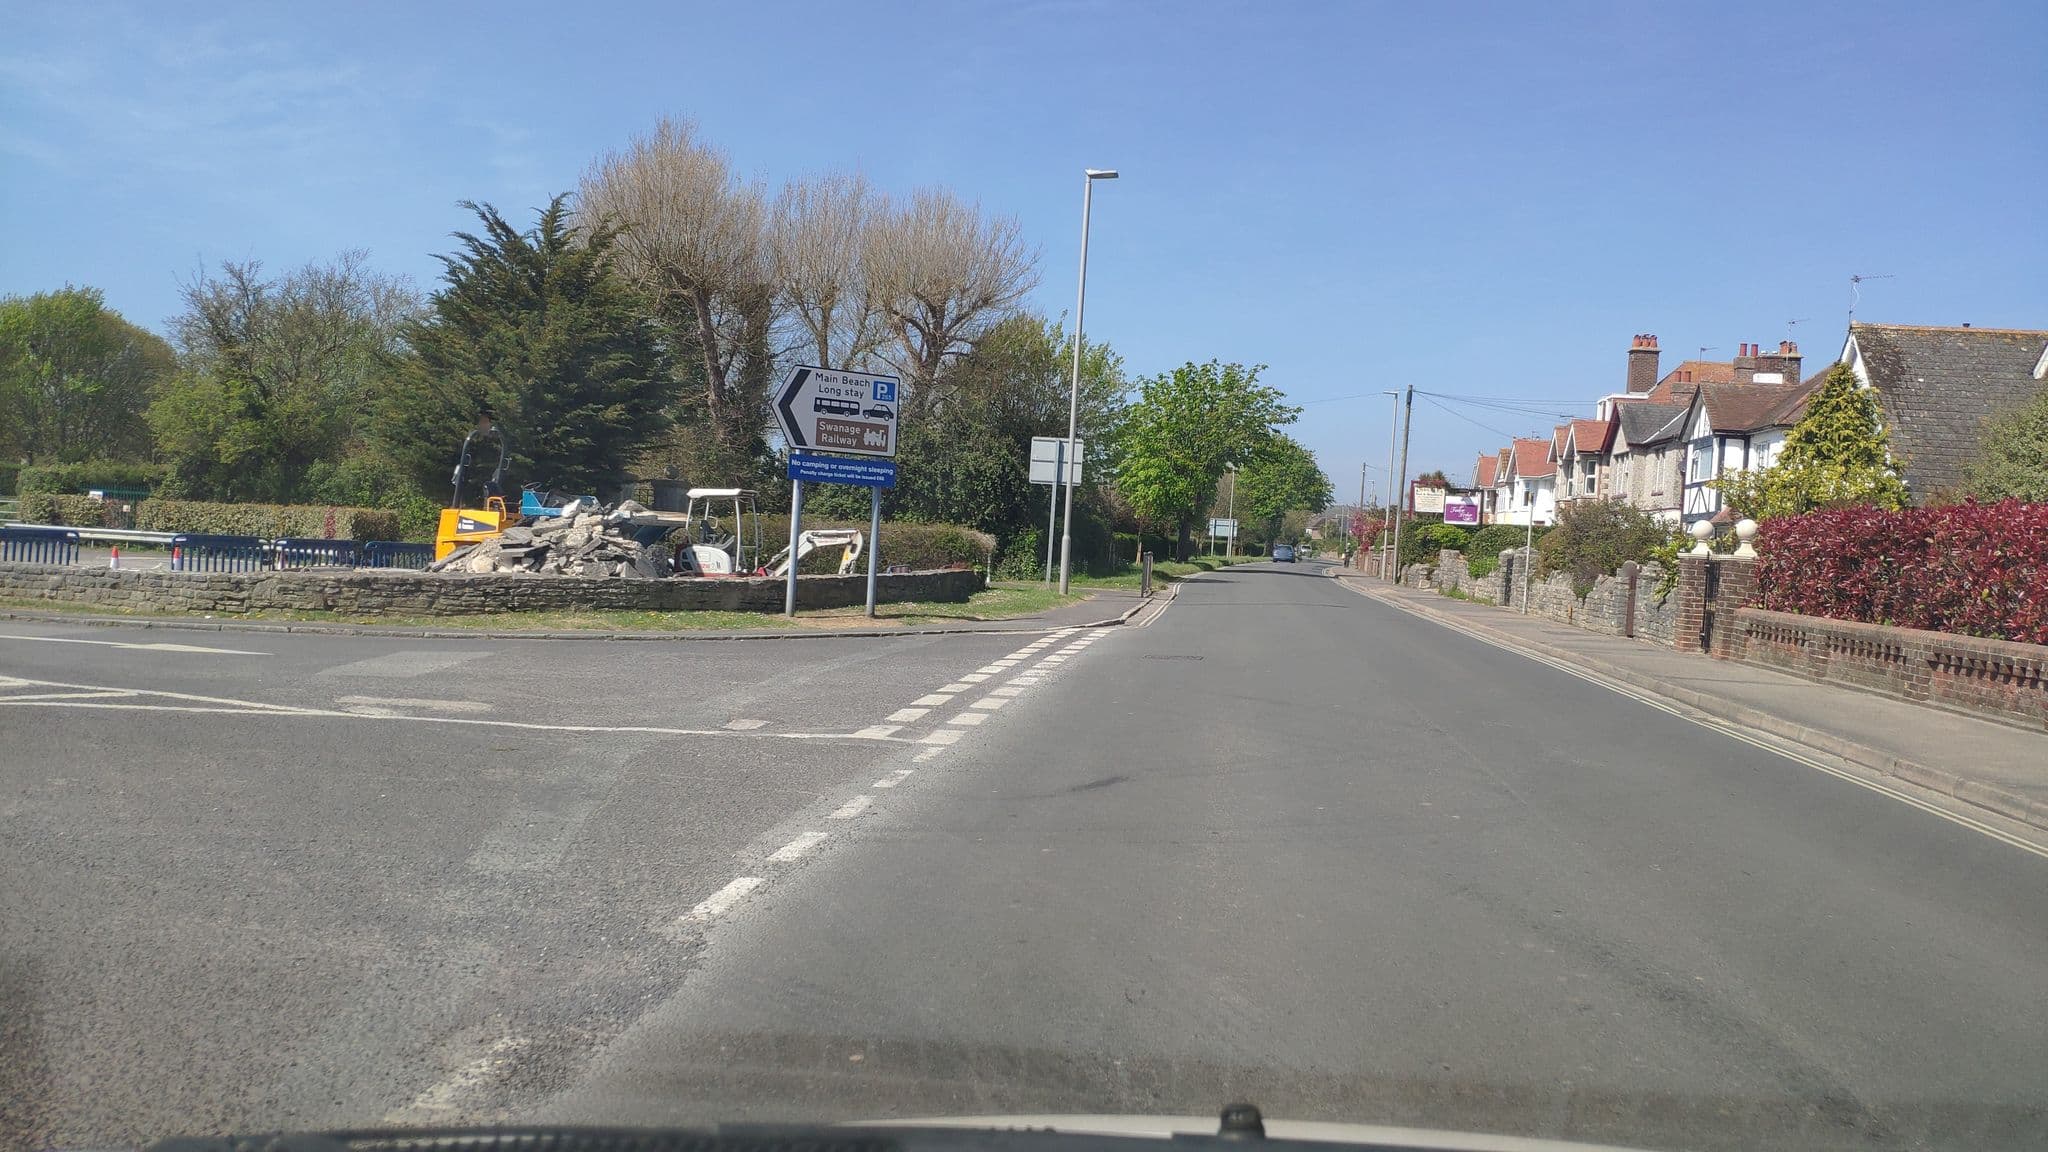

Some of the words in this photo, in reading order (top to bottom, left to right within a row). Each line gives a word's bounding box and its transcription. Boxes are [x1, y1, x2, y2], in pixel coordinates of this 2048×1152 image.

[815, 373, 838, 383] Main
[842, 376, 870, 387] Beach
[818, 384, 841, 396] Long
[845, 388, 864, 399] stay
[877, 383, 888, 399] P
[819, 421, 861, 435] Swanage
[821, 433, 858, 446] Railway
[802, 461, 829, 470] camping
[838, 464, 867, 473] overnight
[868, 466, 893, 475] sleeping
